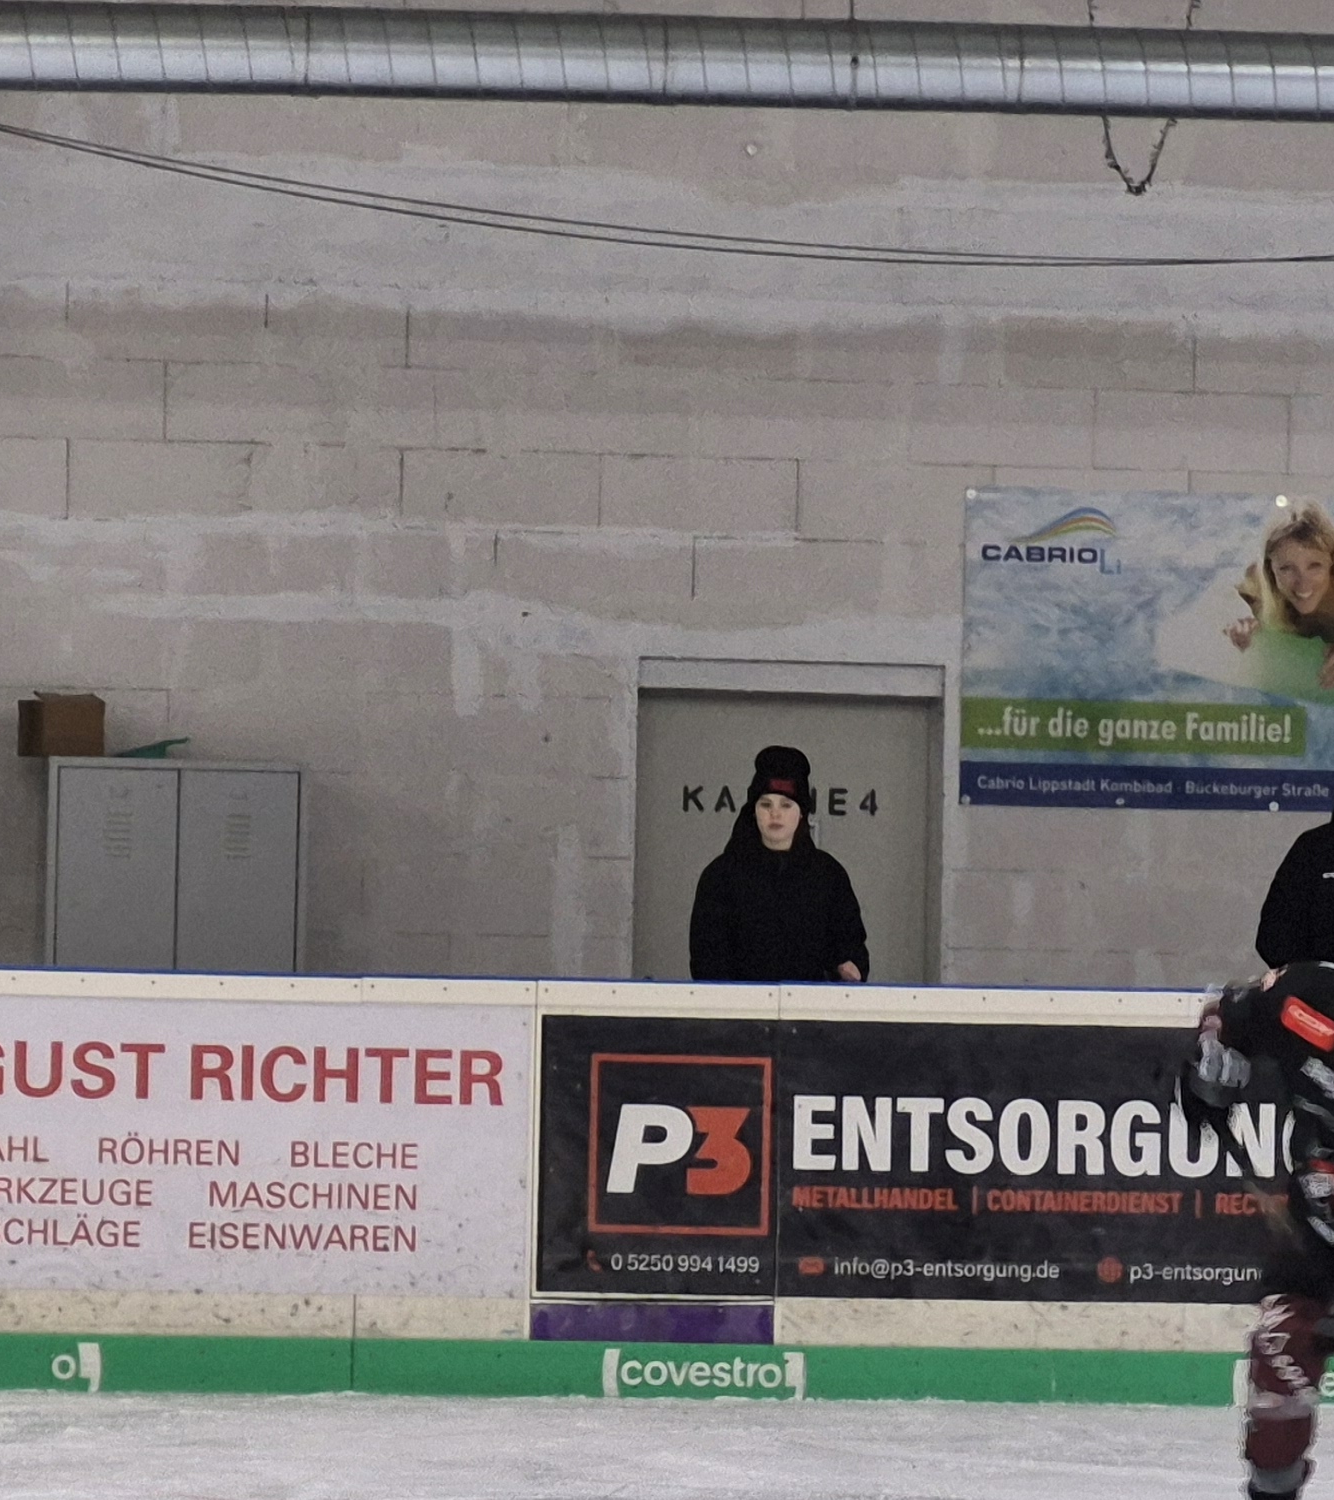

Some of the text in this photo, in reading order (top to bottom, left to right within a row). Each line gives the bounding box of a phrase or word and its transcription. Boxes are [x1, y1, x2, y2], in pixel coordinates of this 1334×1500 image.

[1048, 708, 1088, 738] die
[1098, 716, 1176, 746] ganze
[1186, 712, 1291, 744] Familie!
[682, 784, 878, 817] KAE 4
[977, 775, 1025, 791] Cabrio
[1029, 777, 1096, 794] Lippstadt
[1100, 778, 1173, 793] Kombibad
[1282, 782, 1330, 798] Straße
[190, 1043, 505, 1106] RICHTER
[97, 1131, 240, 1167] RÖHREN
[291, 1140, 420, 1170] BLECHE
[606, 1103, 752, 1196] P3
[208, 1181, 418, 1212] MASCHINEN
[792, 1184, 959, 1213] METALLHANDEL
[986, 1189, 1182, 1216] CONTAINERDIENST
[188, 1222, 418, 1253] EISENWAREN
[834, 1257, 1060, 1282] info@p3-entsorgung.de
[619, 1355, 786, 1391] covestro
